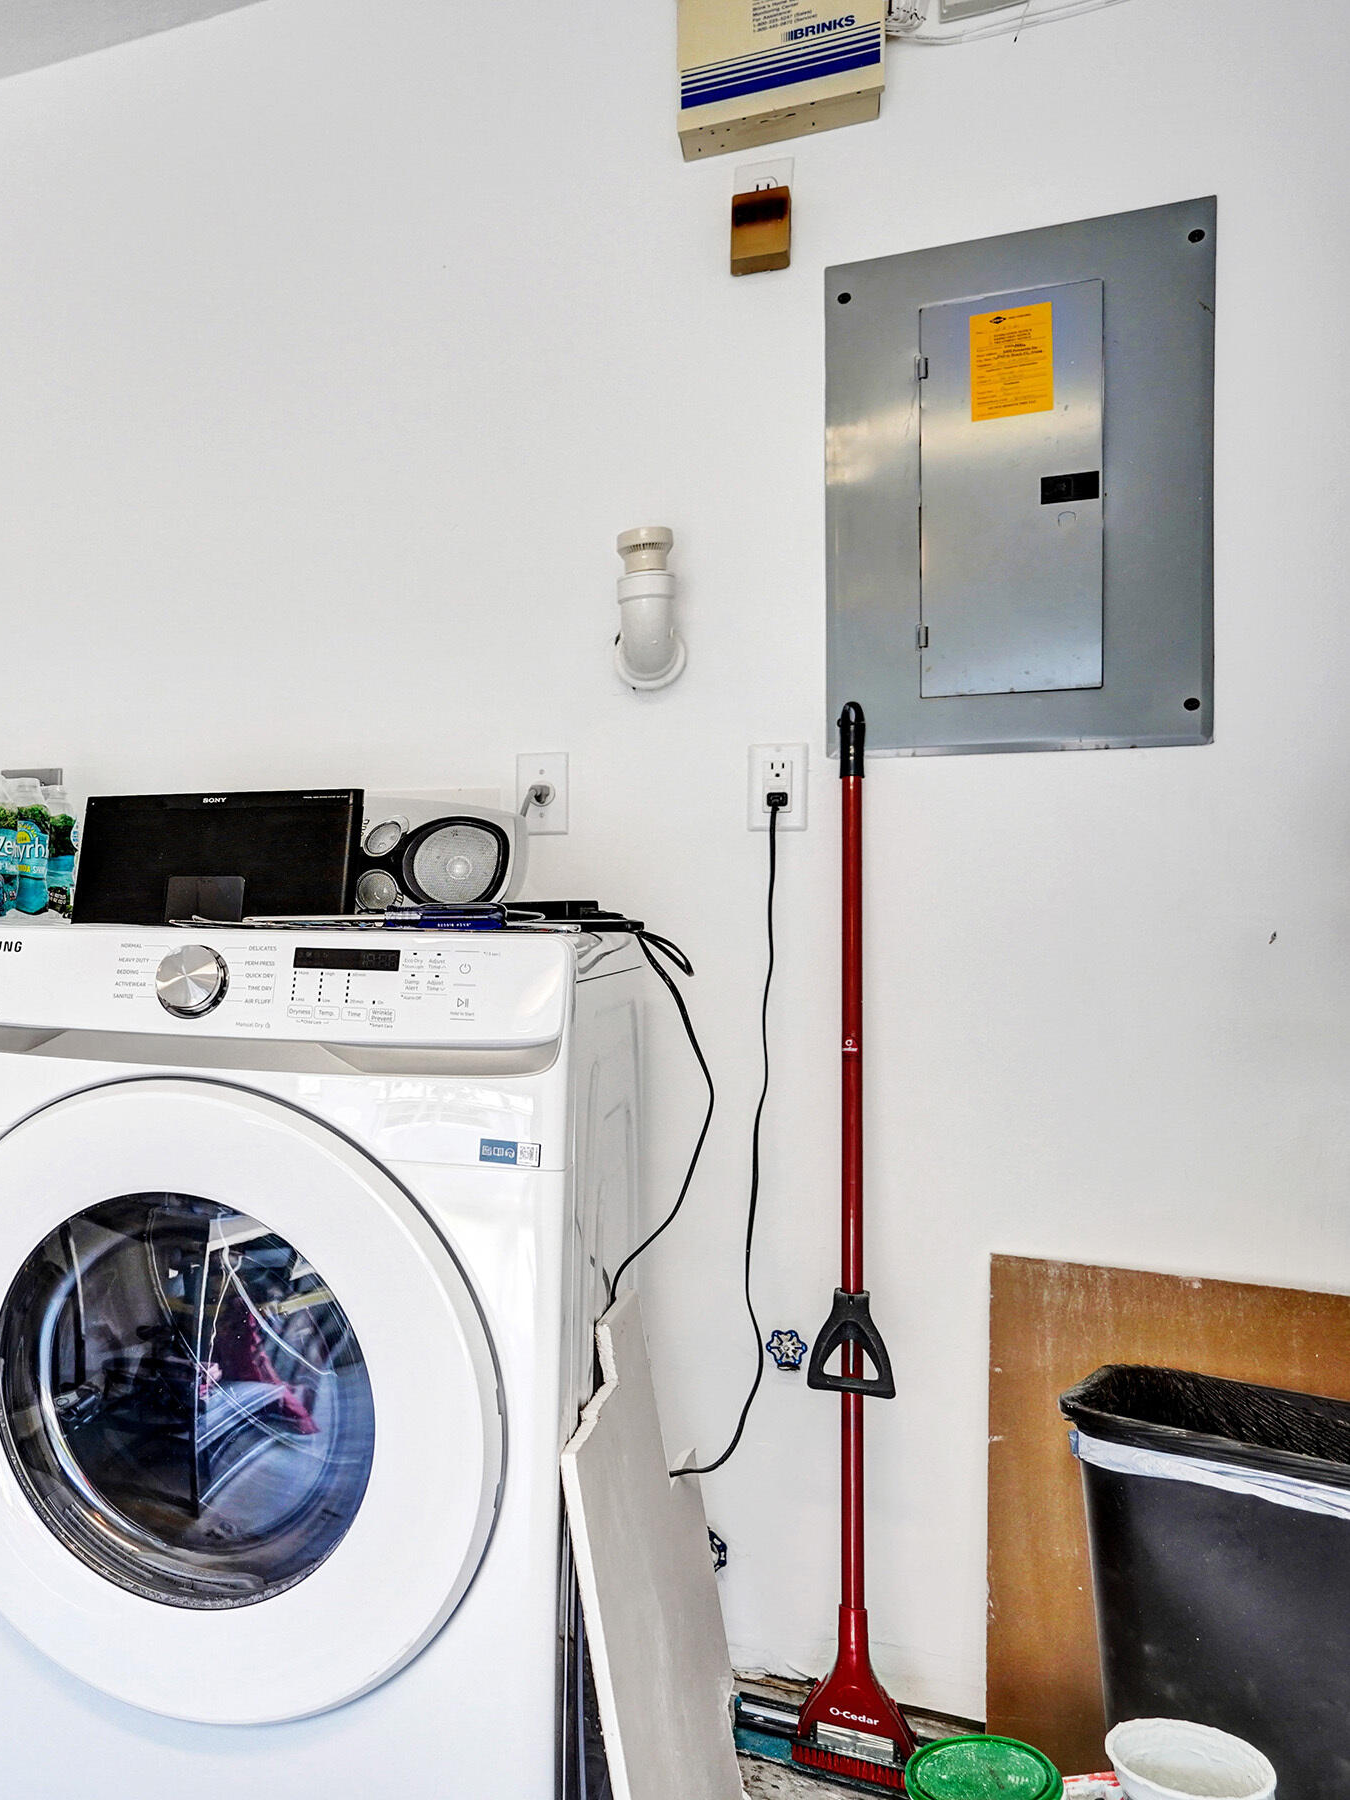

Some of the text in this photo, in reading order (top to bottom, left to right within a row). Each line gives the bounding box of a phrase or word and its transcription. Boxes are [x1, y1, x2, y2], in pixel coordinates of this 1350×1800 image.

[793, 14, 856, 40] BRINKS
[289, 1008, 311, 1016] Dryness
[829, 1706, 880, 1726] O-Cedar
